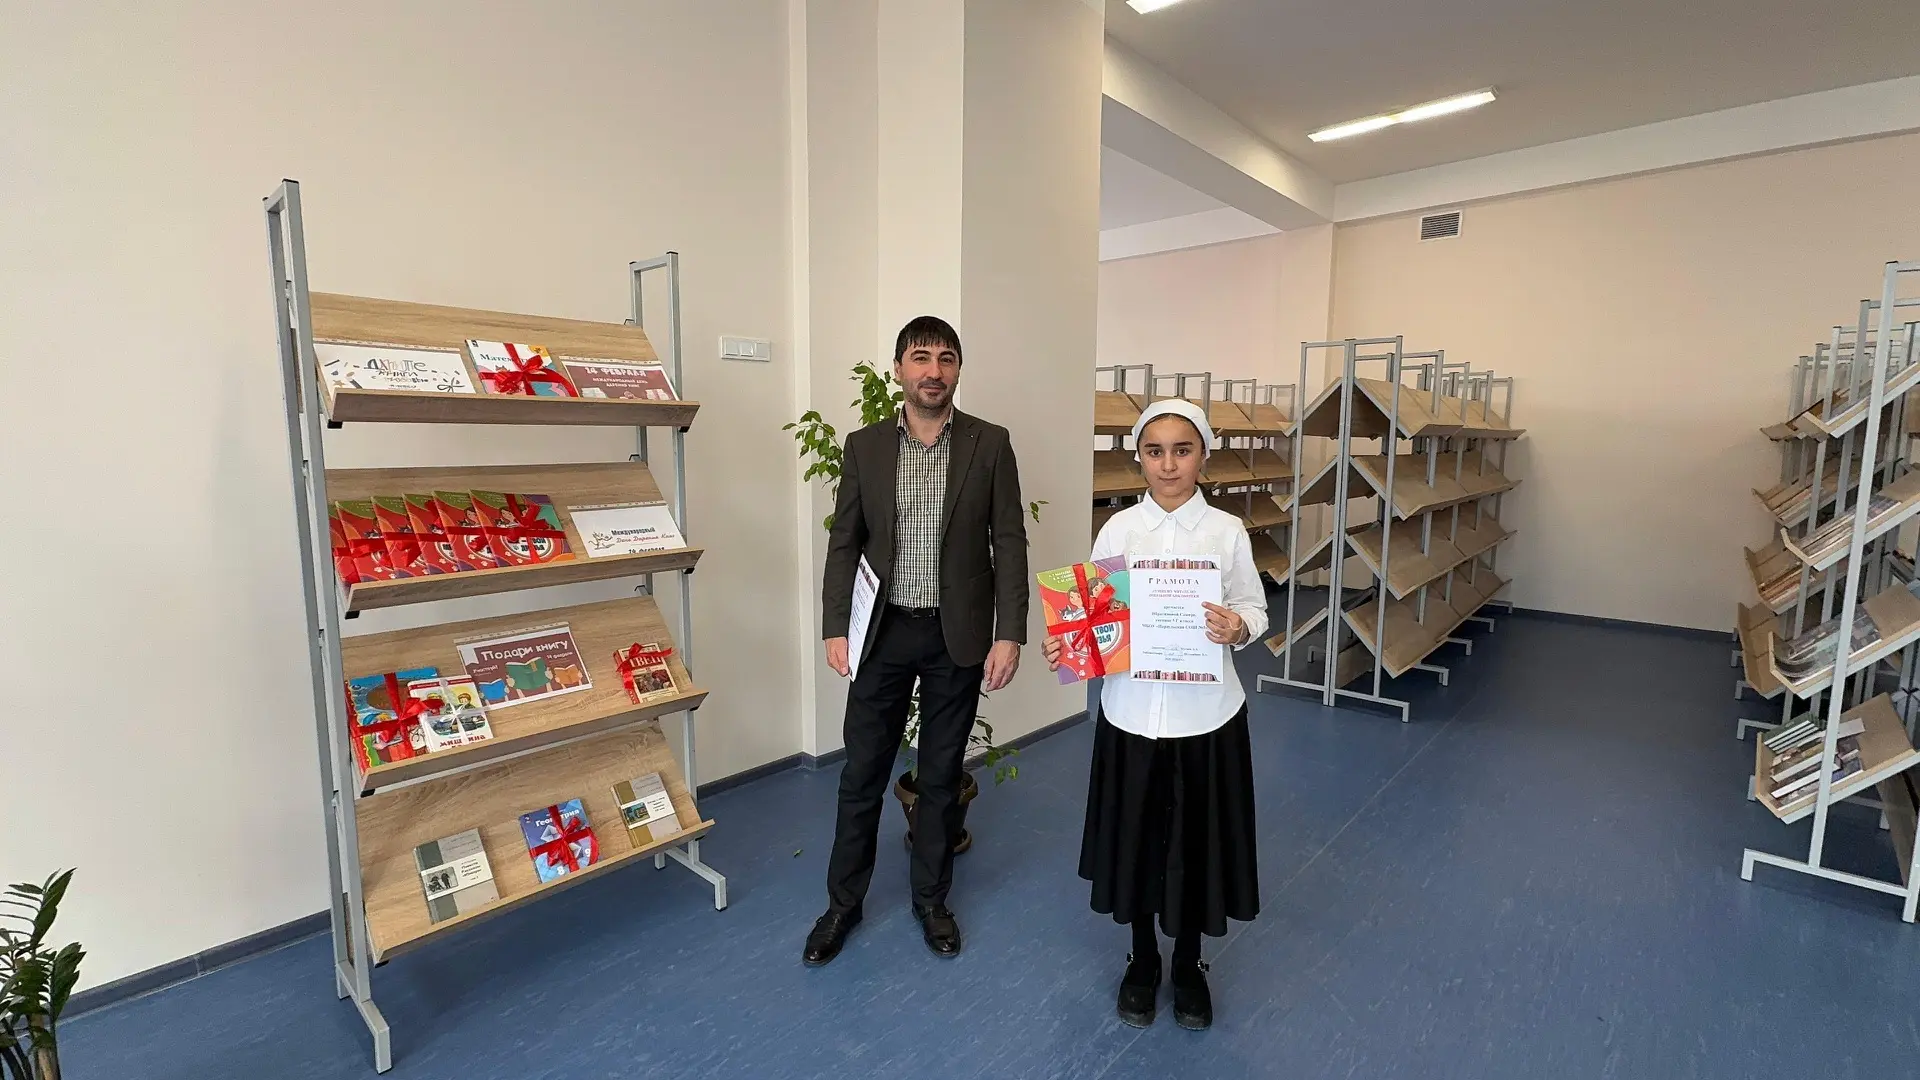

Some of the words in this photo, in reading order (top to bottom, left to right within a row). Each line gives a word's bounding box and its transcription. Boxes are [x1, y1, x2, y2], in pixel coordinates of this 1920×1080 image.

[611, 526, 656, 536] Международный
[1148, 577, 1200, 585] ГРАМОТА
[1095, 623, 1115, 635] ТВОИ
[480, 649, 533, 661] Подари
[556, 866, 565, 875] 8
